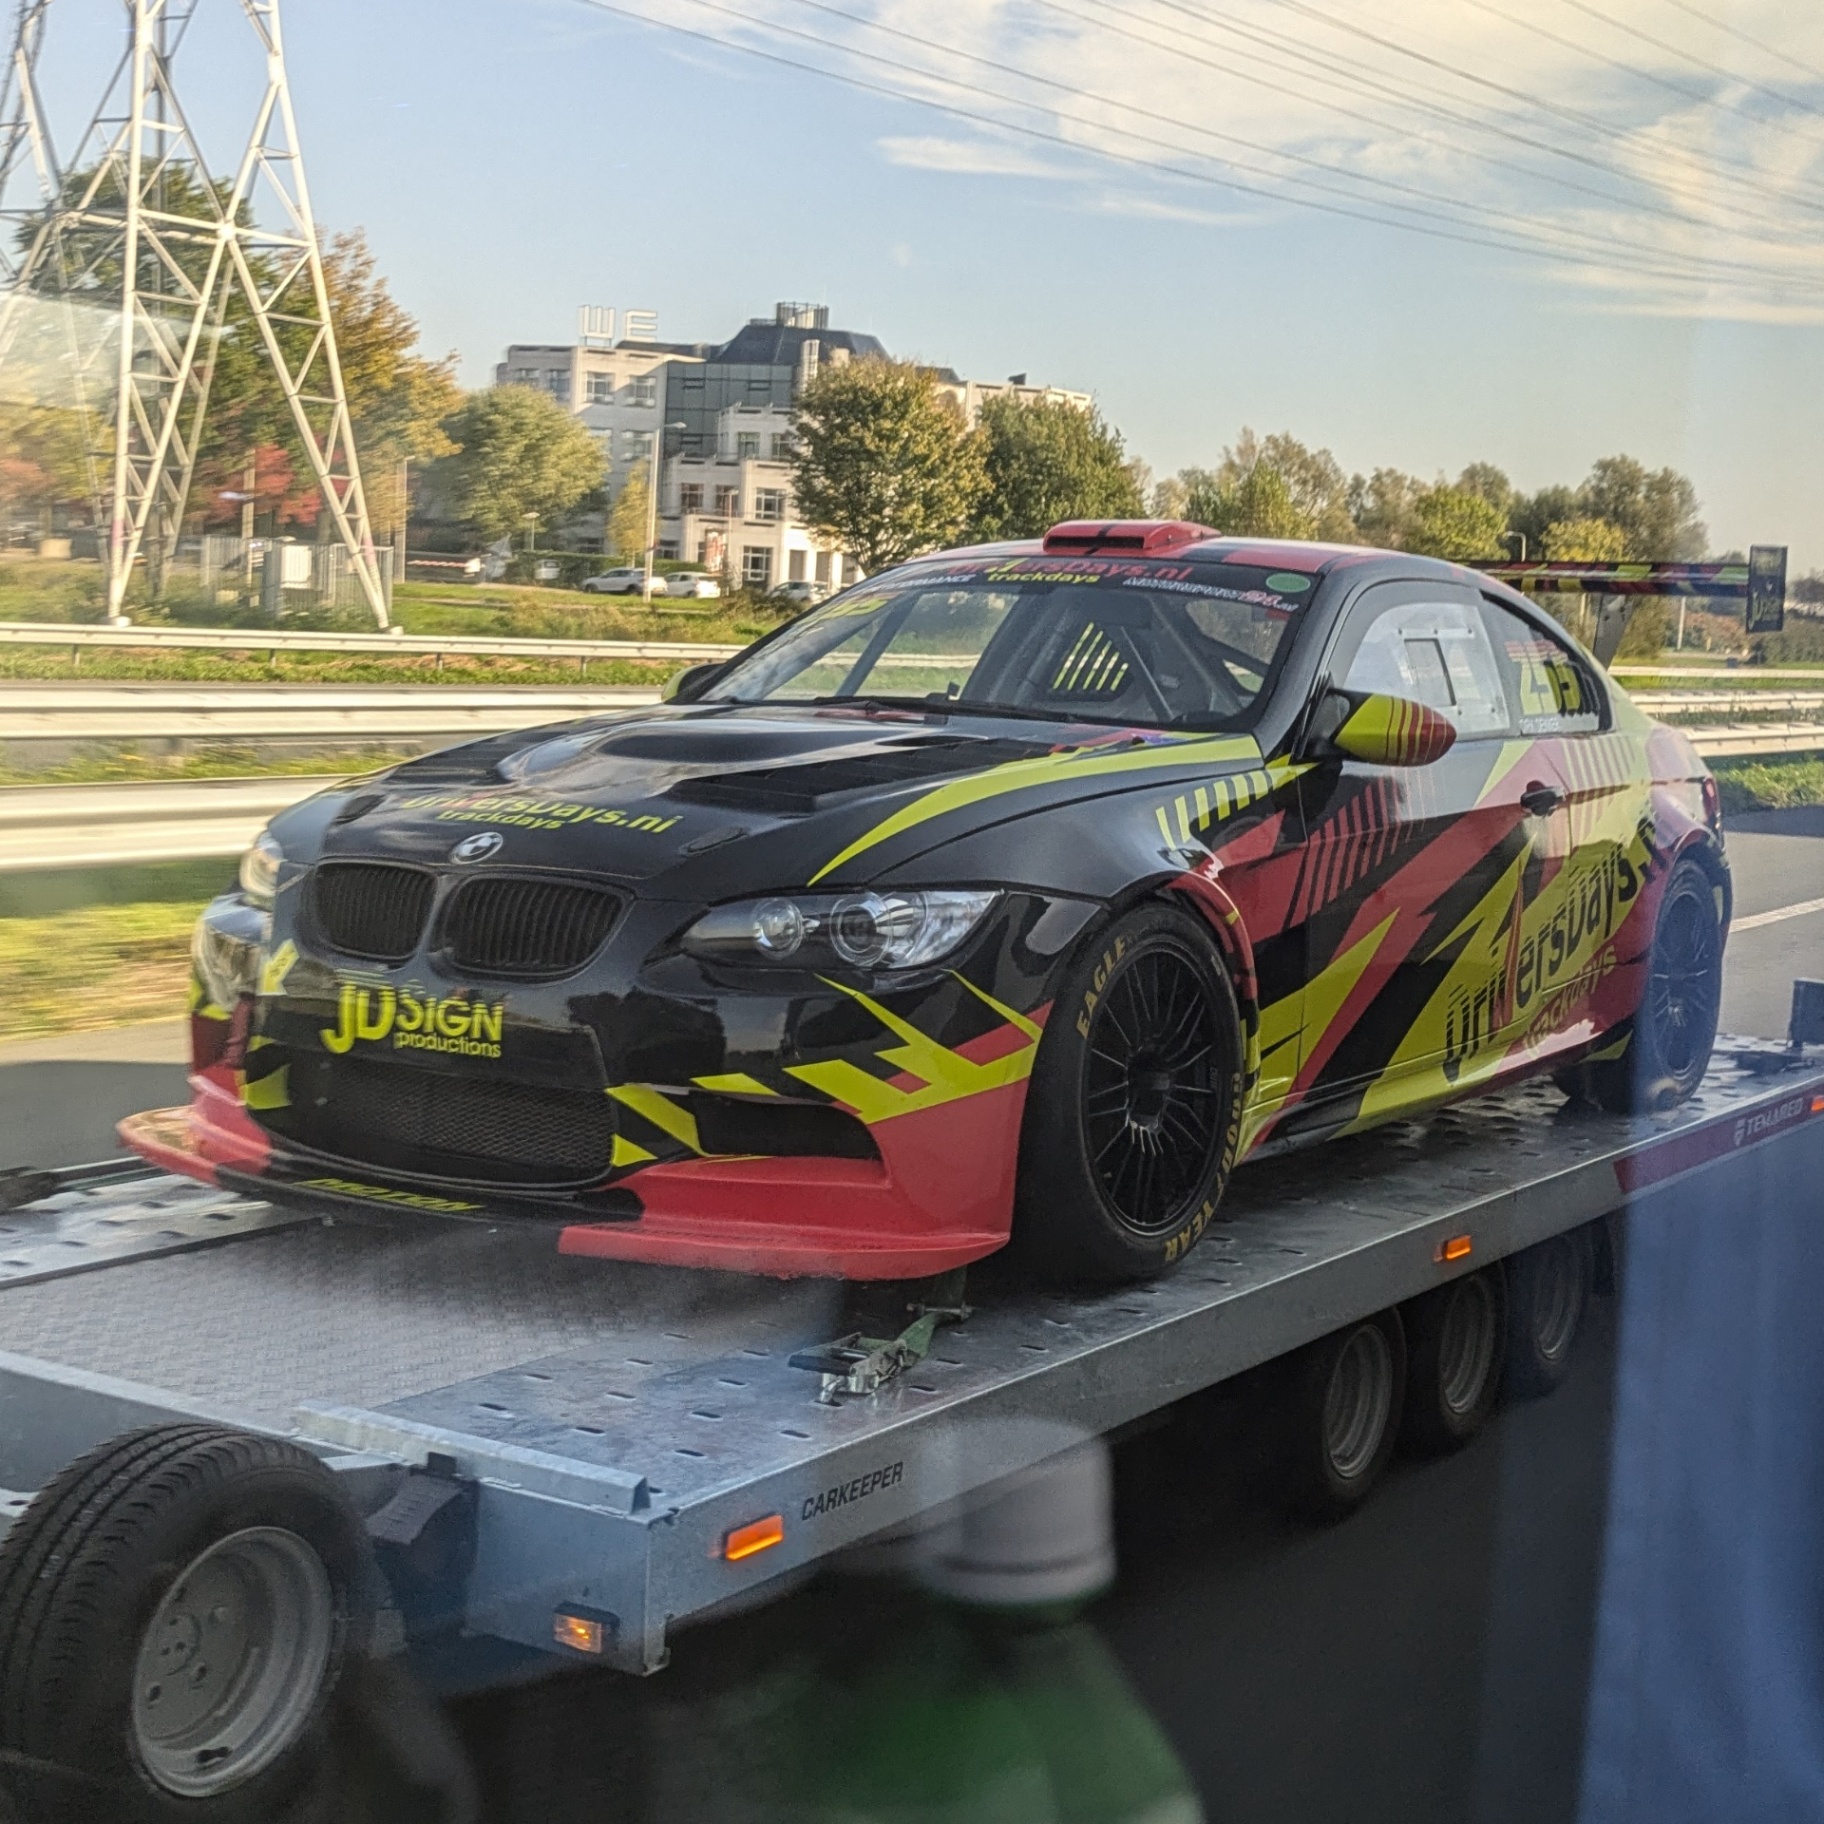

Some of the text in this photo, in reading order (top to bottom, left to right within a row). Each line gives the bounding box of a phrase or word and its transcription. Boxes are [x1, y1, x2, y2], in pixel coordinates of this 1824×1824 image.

[987, 571, 1101, 584] trackdays
[436, 809, 567, 830] trackdays
[1076, 935, 1126, 1039] EAGLE
[394, 1031, 502, 1058] productions
[801, 1461, 904, 1521] CARKEEPER
